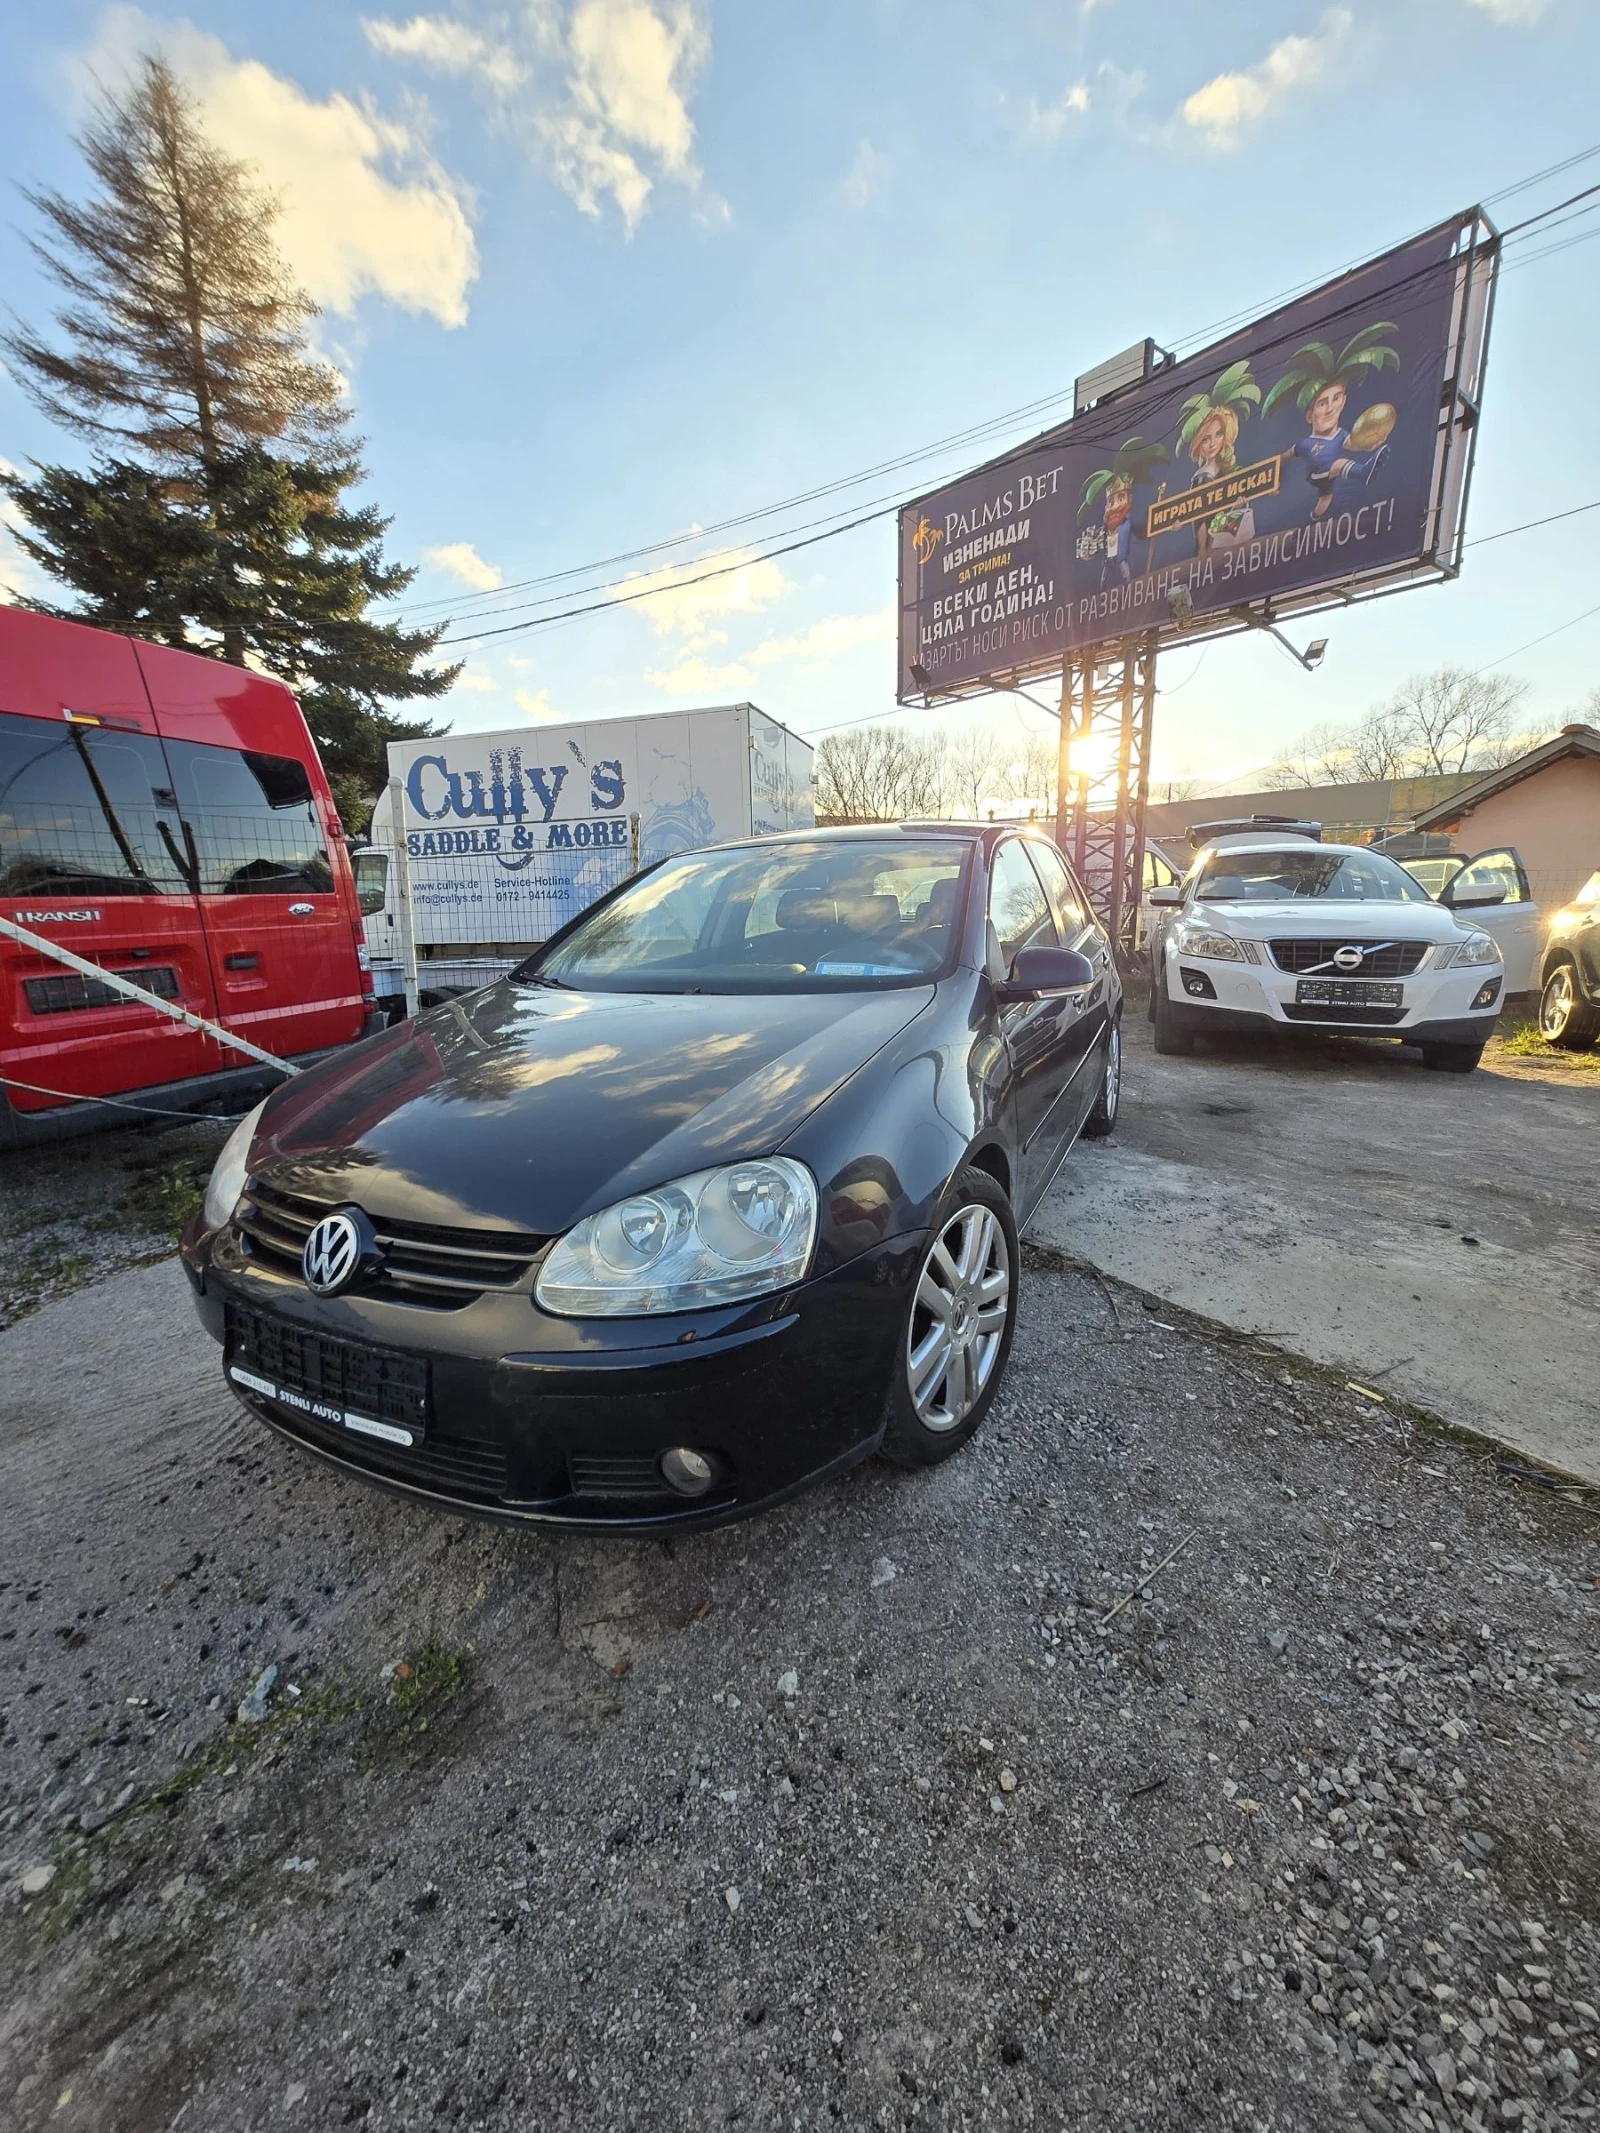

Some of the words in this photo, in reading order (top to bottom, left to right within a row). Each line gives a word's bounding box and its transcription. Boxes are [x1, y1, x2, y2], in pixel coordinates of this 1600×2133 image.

[944, 491, 1013, 546] PALMS
[1018, 466, 1063, 512] BET
[1153, 495, 1203, 525] ИГРАТА
[1207, 486, 1224, 504] ТЕ
[1226, 469, 1274, 498] ИСКА!
[942, 519, 1030, 574] ИЗНЕНАДИ
[958, 569, 971, 584] ЗА
[973, 553, 1011, 578] ТРИМА!
[973, 624, 1008, 657] НОСИ
[1012, 611, 1049, 644] РИСК
[1054, 602, 1074, 631] ОТ
[1079, 570, 1180, 624] РАЗВИВАНЕ
[1189, 557, 1214, 590] НА
[1221, 497, 1396, 581] ЗАВИСИМОСТ!
[933, 581, 988, 620] ВСЕКИ
[994, 564, 1039, 599] ДЕН,
[921, 615, 964, 645] ЦЯЛА
[971, 580, 1054, 628] ГОДИНА!
[407, 827, 501, 856] SADDLE
[511, 825, 534, 850] &
[545, 819, 628, 849] MORE
[412, 879, 479, 892] www.cullys.de
[413, 893, 483, 907] info@cullys.de
[494, 876, 571, 888] Service-Hotline
[496, 891, 520, 902] 0172
[528, 889, 570, 900] 9414425
[312, 1404, 342, 1422] AUTO
